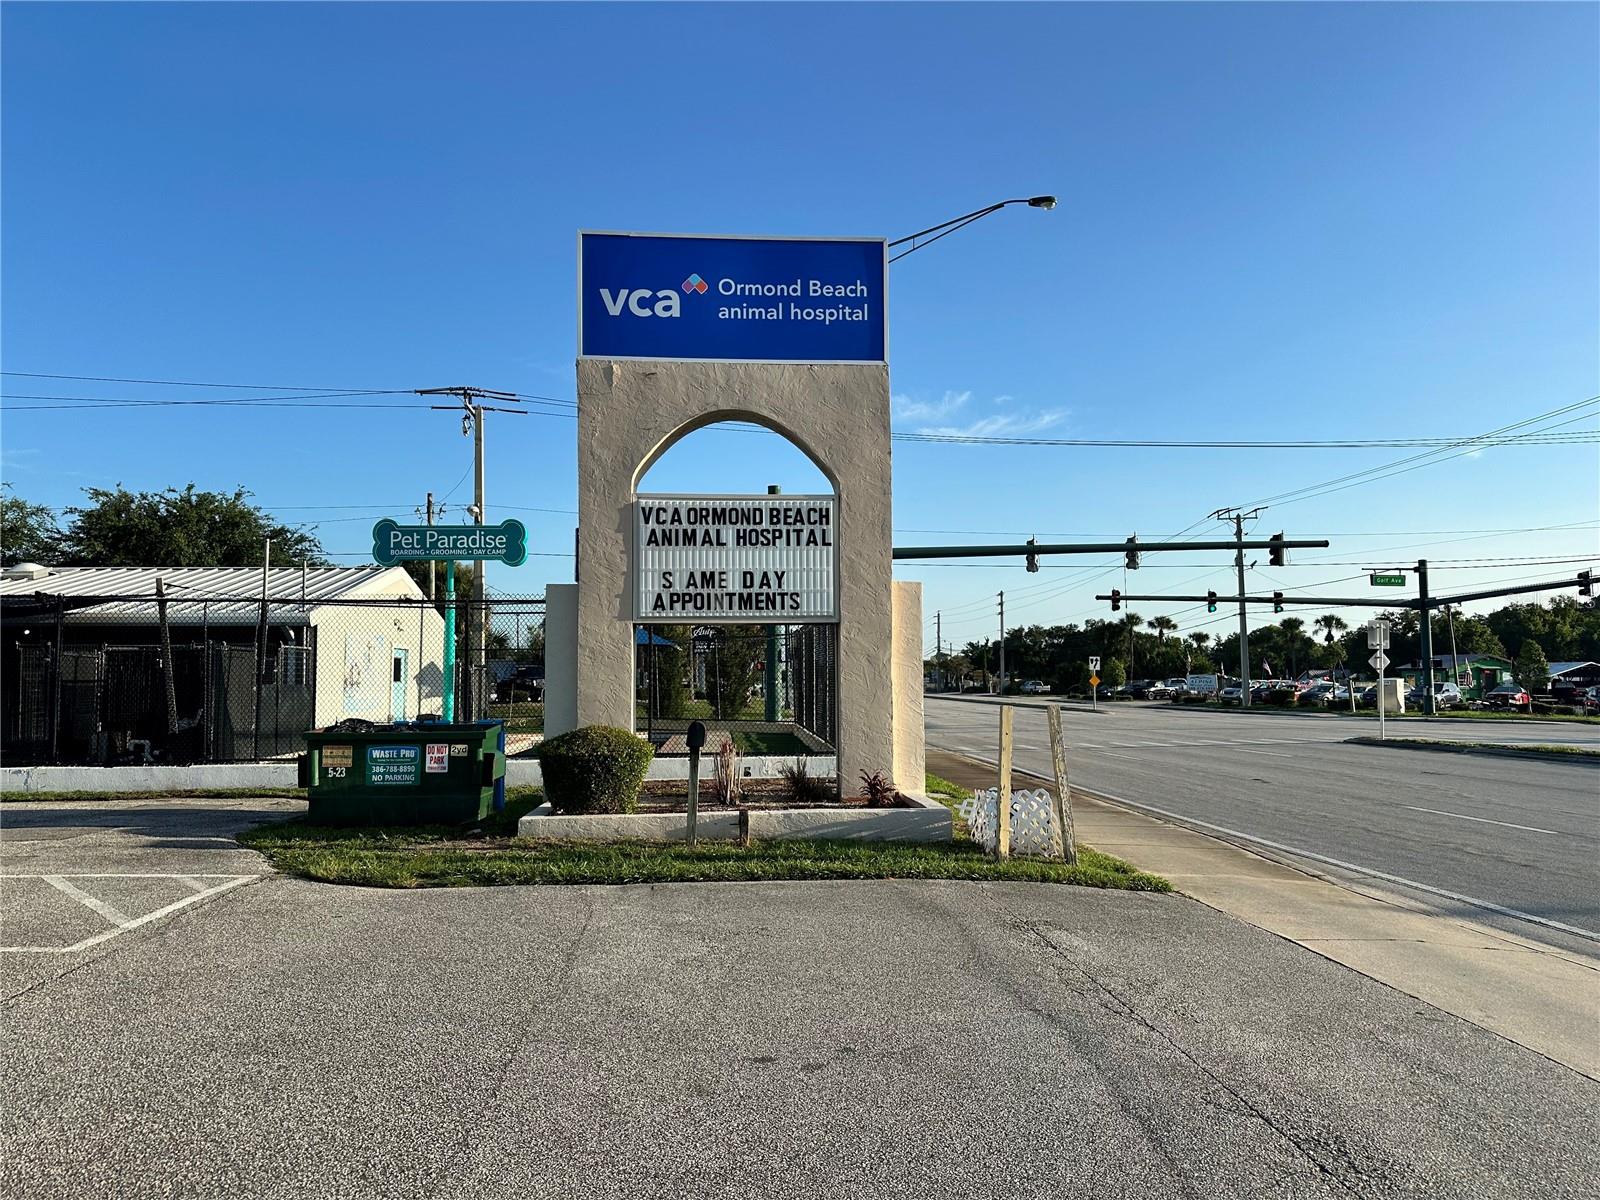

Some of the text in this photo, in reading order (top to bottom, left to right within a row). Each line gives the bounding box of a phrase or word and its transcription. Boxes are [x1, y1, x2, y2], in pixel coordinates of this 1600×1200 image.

[718, 278, 868, 297] Ormond Beach
[600, 288, 681, 318] vca
[718, 303, 868, 325] animal hospital
[641, 507, 830, 526] VCA ORMOND BEACH
[390, 530, 507, 548] Pet Paradise
[646, 528, 832, 546] ANIMAL HOSPITAL
[742, 571, 786, 589] DAY
[652, 592, 800, 611] APPOINTMENTS
[372, 749, 415, 758] WASTE PRO
[428, 746, 448, 755] DO NOT
[452, 746, 468, 755] 2yd
[430, 756, 445, 765] PARK
[328, 767, 346, 778] 5-23
